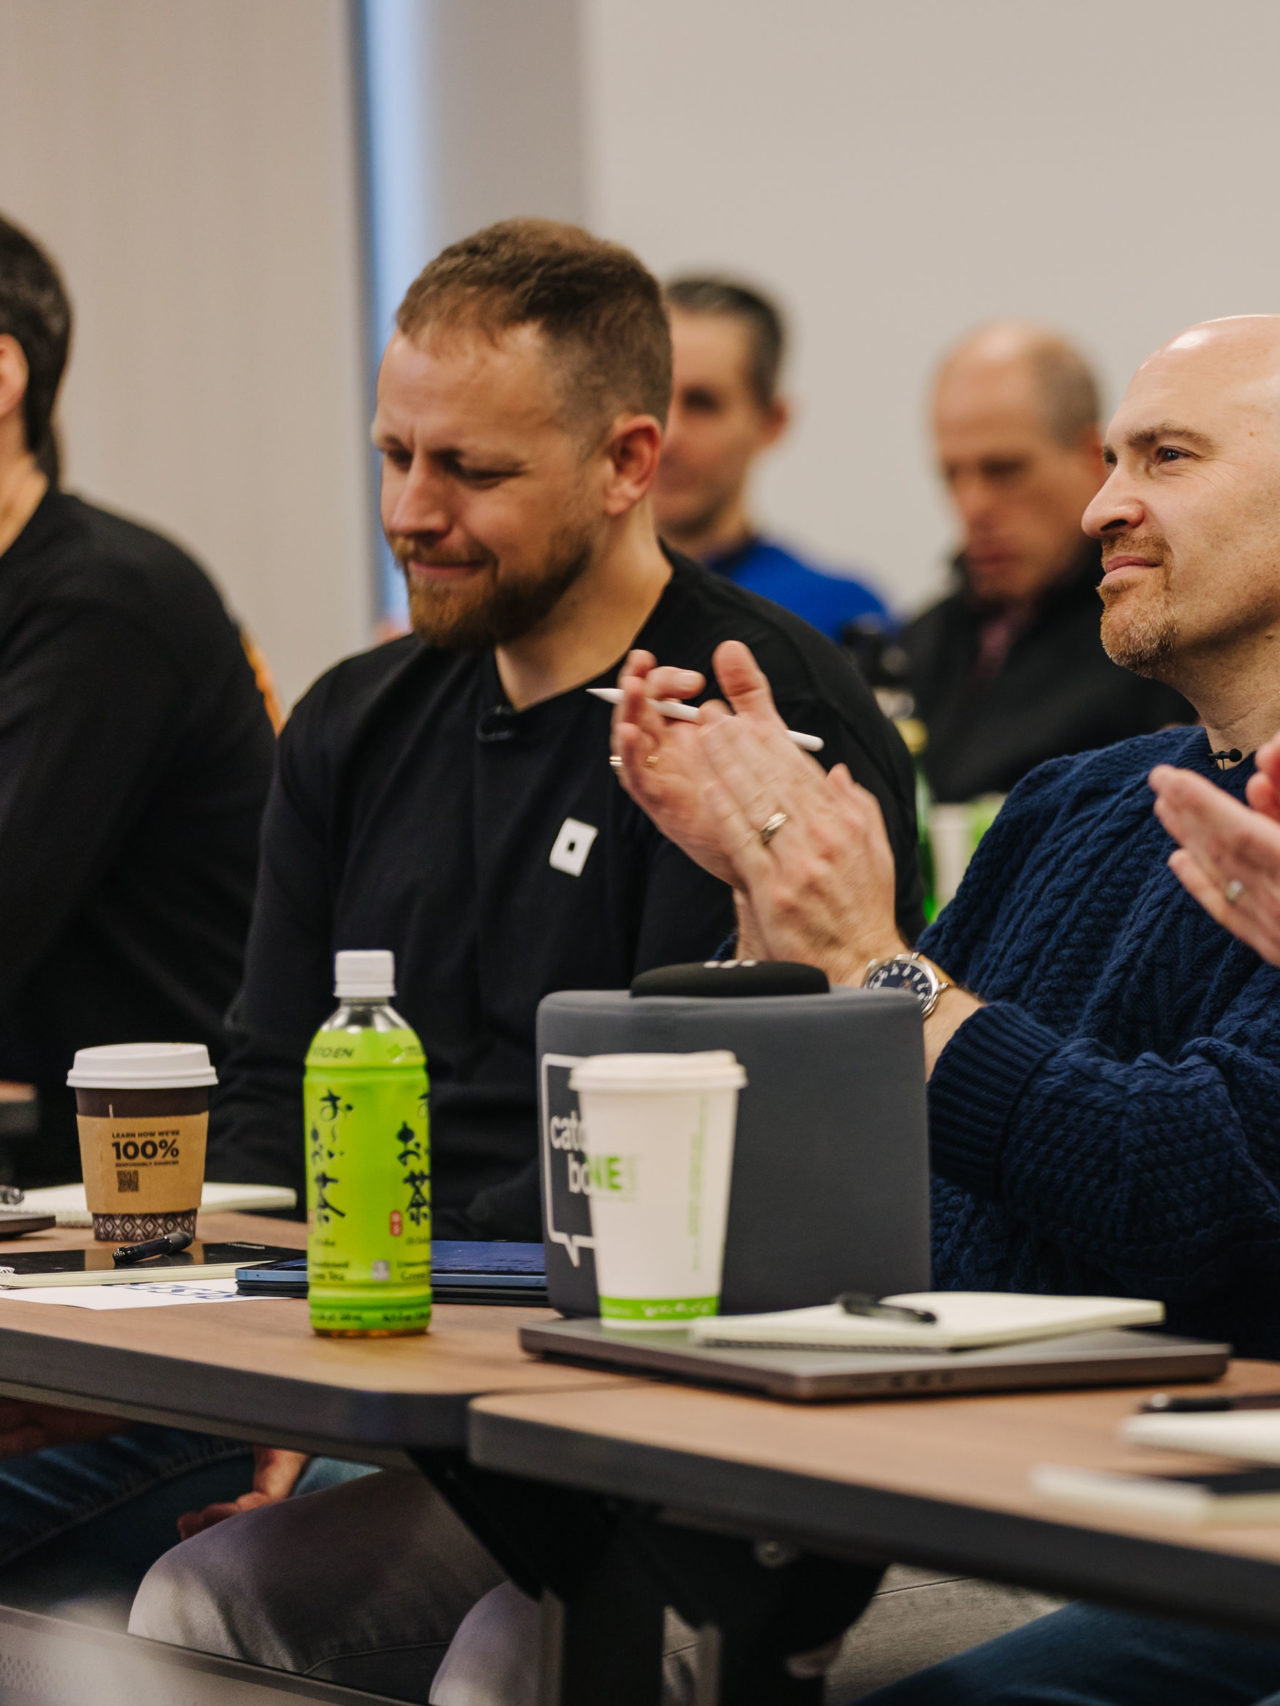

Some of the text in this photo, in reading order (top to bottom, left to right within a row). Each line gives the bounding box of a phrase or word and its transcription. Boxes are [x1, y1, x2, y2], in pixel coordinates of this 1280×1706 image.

[111, 1138, 180, 1160] 100%
[550, 1110, 585, 1151] cat
[567, 1152, 590, 1195] bo
